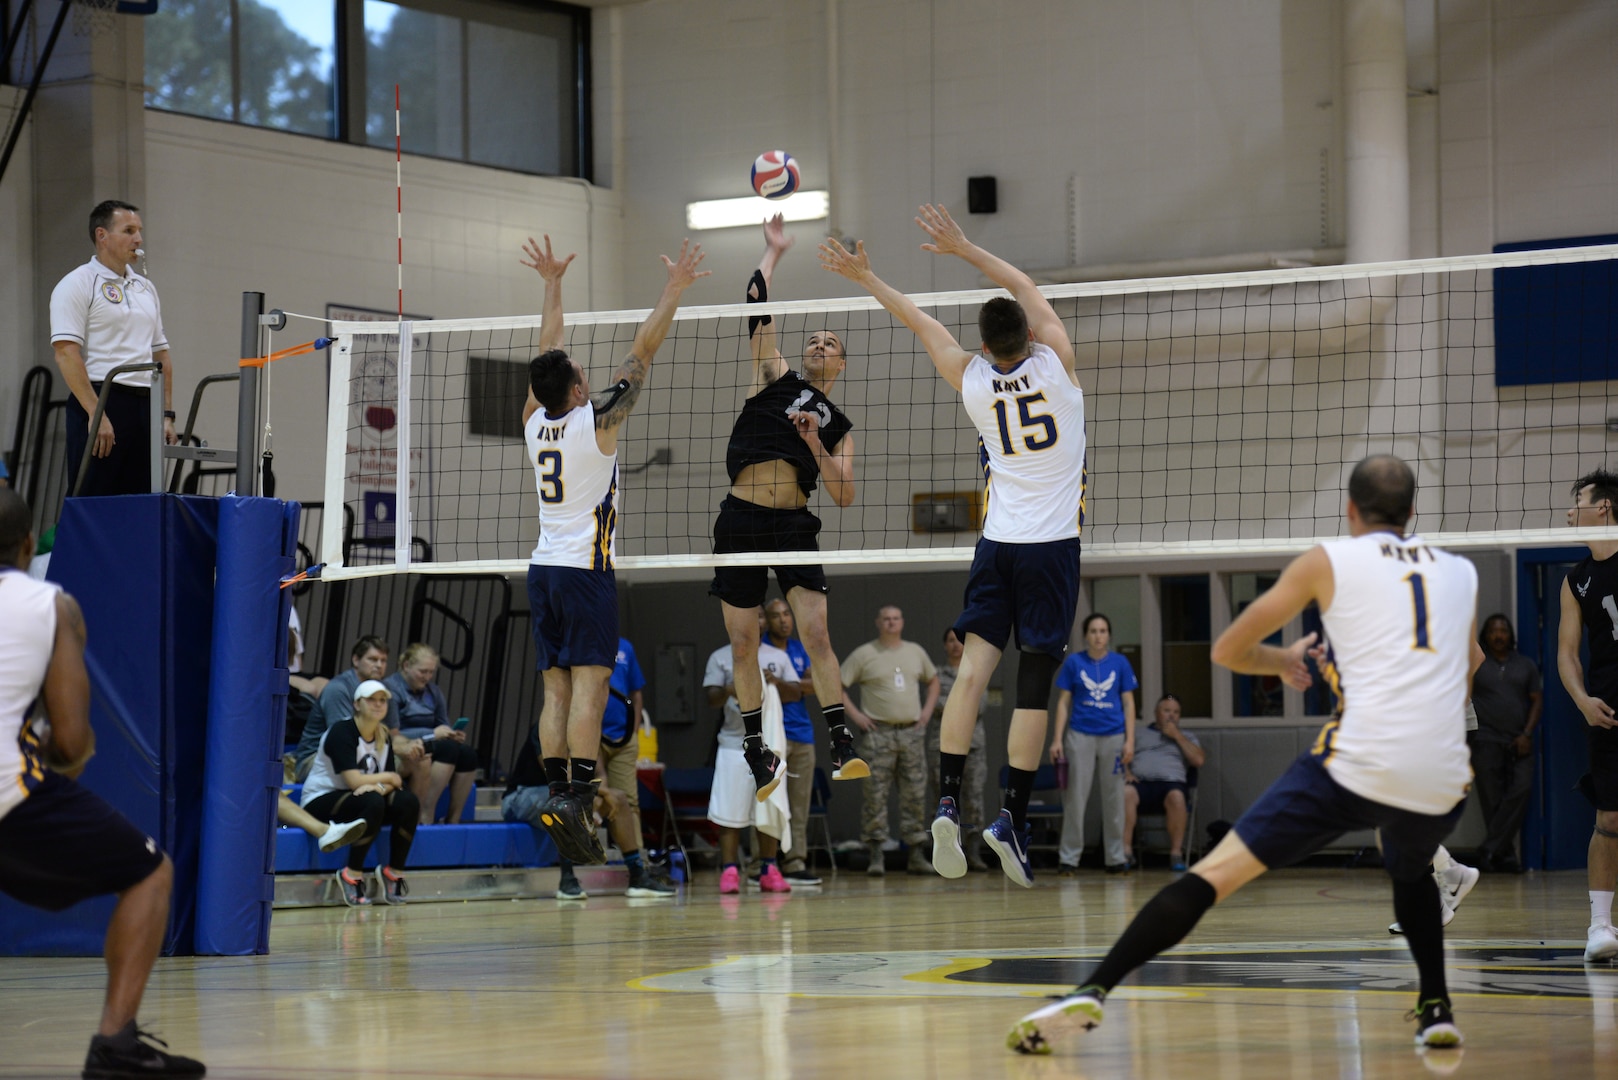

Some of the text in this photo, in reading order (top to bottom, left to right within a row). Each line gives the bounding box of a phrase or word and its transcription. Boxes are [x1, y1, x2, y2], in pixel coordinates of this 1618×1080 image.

[992, 375, 1030, 393] NAVY
[989, 389, 1060, 456] 15
[537, 447, 567, 505] 3
[1401, 569, 1438, 654] 1
